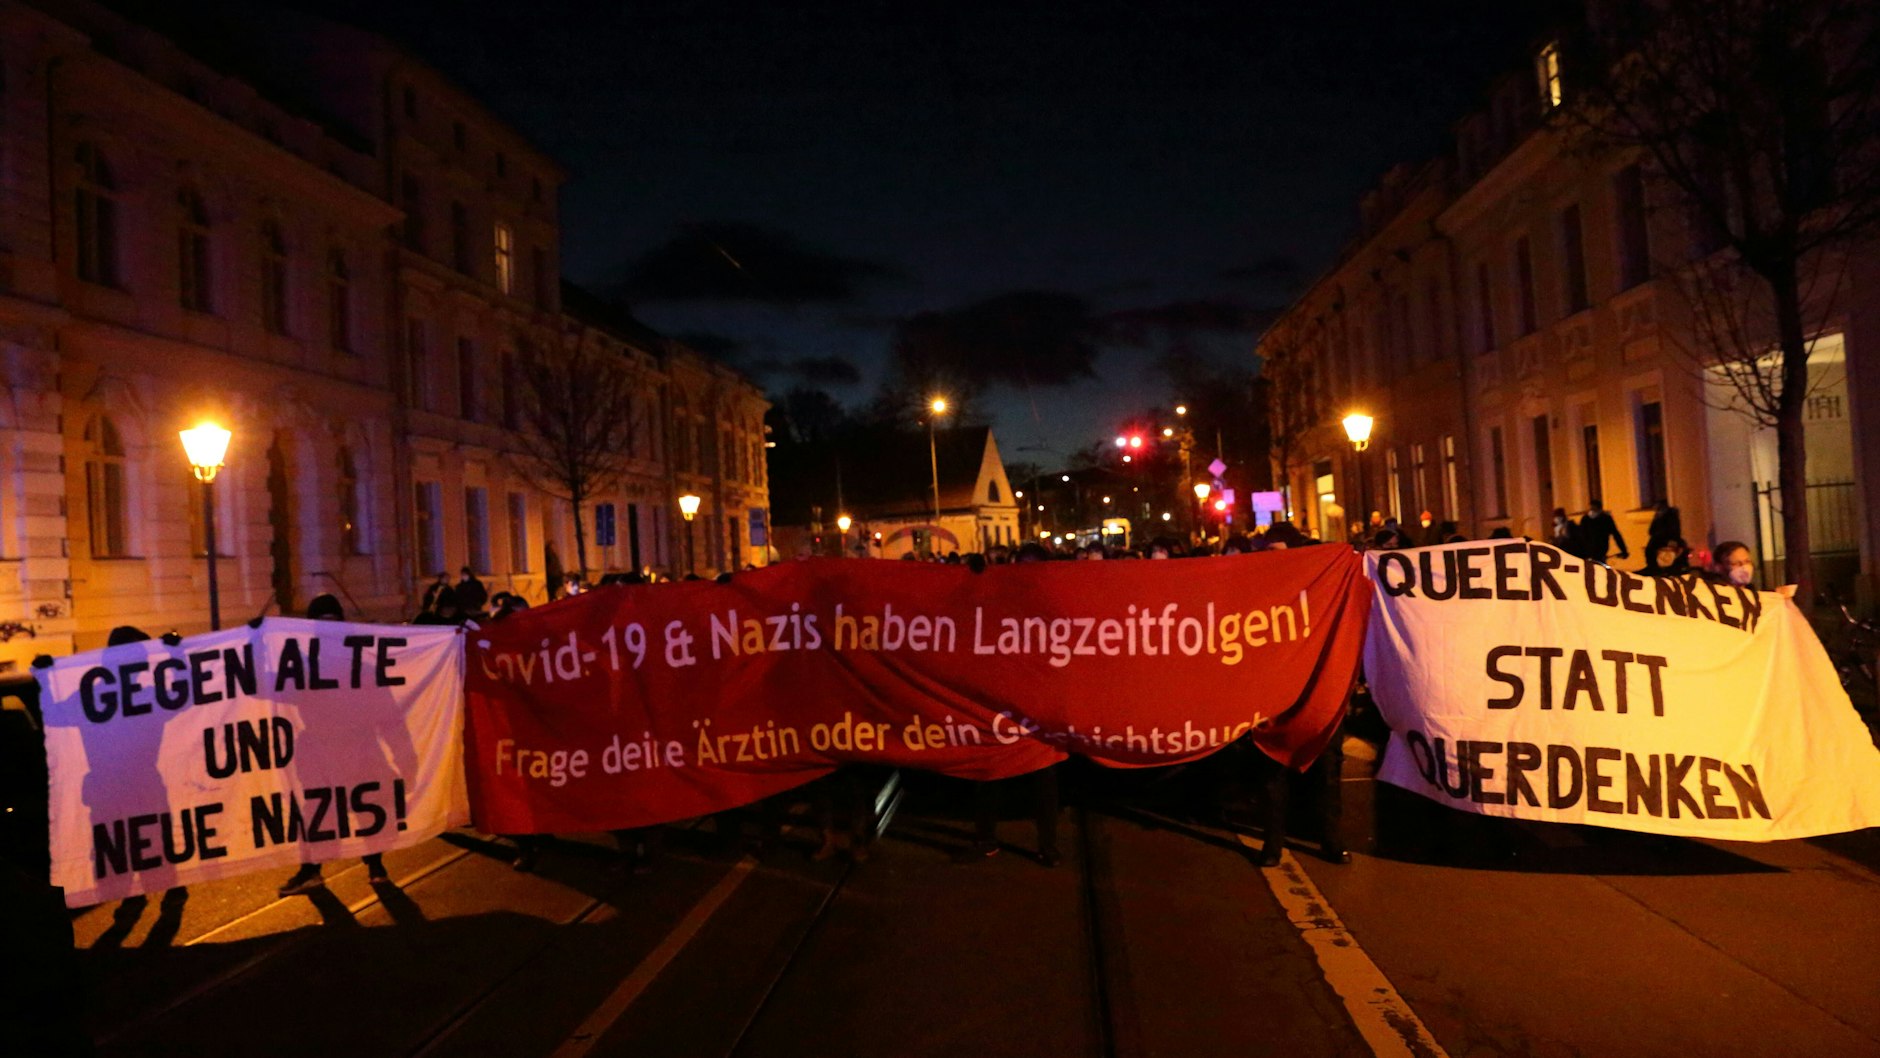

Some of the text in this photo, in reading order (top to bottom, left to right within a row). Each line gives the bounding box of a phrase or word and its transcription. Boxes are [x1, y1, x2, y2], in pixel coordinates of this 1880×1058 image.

[665, 619, 697, 668] &
[710, 602, 822, 660] Nazis
[834, 603, 956, 654] haben
[973, 589, 1311, 668] Langzeitfolgen!
[1377, 542, 1763, 635] QUEER-DENKEN
[79, 634, 408, 724] GEGEN ALTE
[1486, 644, 1669, 717] STATT
[203, 716, 295, 780] UND
[496, 738, 589, 788] Frage
[692, 717, 800, 768] Ärztin
[809, 711, 891, 752] oder
[902, 713, 983, 752] dein
[1406, 729, 1773, 821] QUERDENKEN
[92, 778, 409, 880] NEUE NAZIS!
